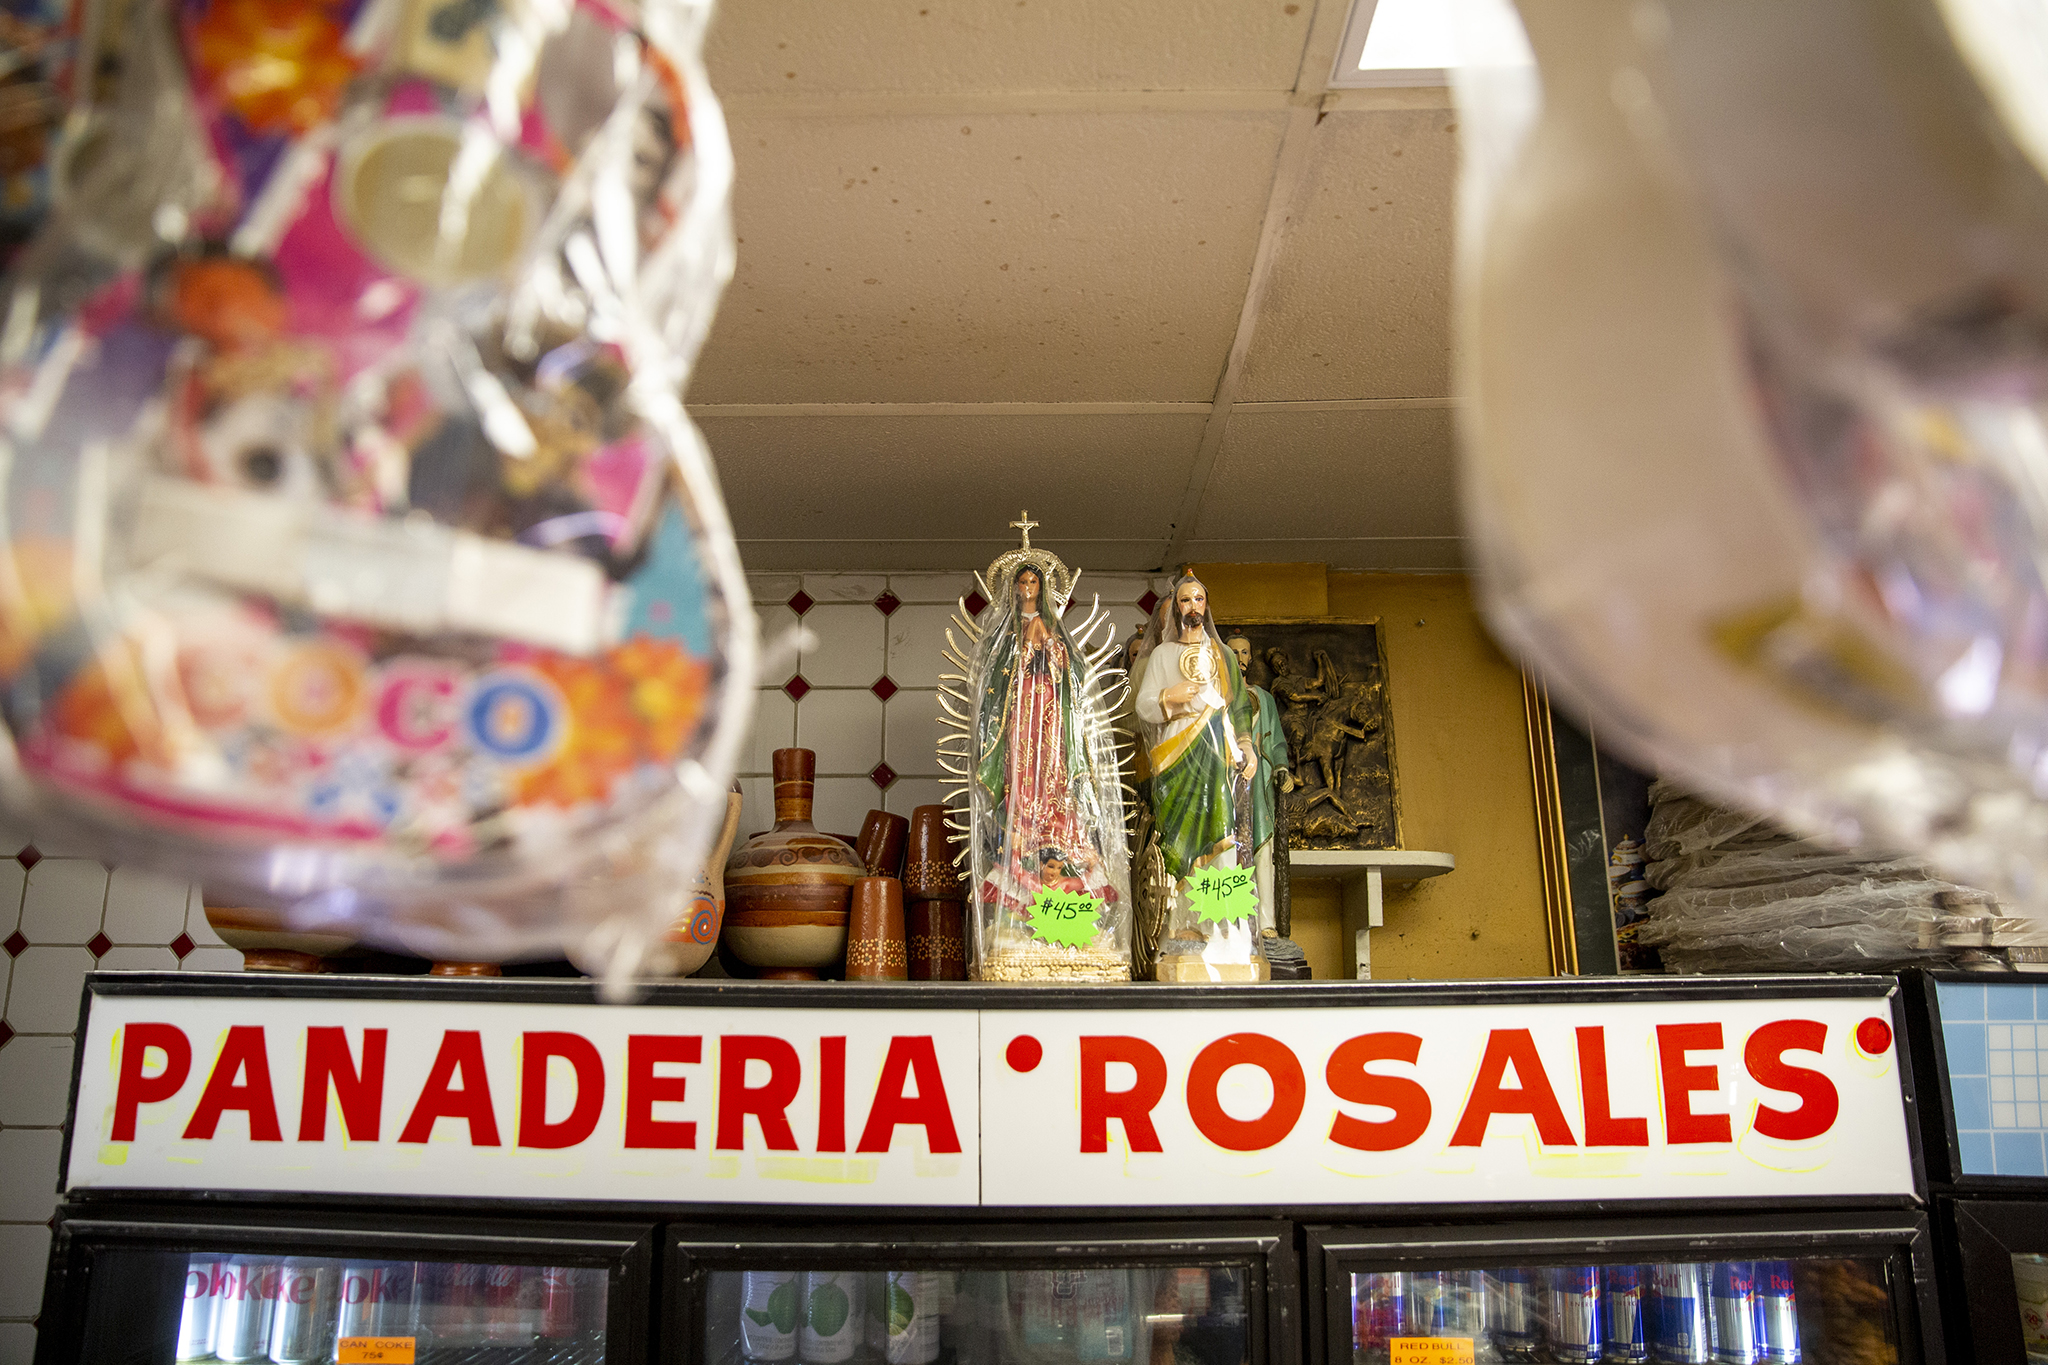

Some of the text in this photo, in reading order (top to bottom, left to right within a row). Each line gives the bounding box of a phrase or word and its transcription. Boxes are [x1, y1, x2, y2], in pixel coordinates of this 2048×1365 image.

[110, 1019, 1840, 1154] PANADERIA ROSALES
[1609, 1269, 1638, 1286] Red
[1730, 1275, 1753, 1291] Red
[340, 1340, 413, 1349] CAN COKE
[1400, 1342, 1464, 1350] RED BULL
[1394, 1356, 1402, 1364] 8
[1440, 1356, 1474, 1364] $2.50
